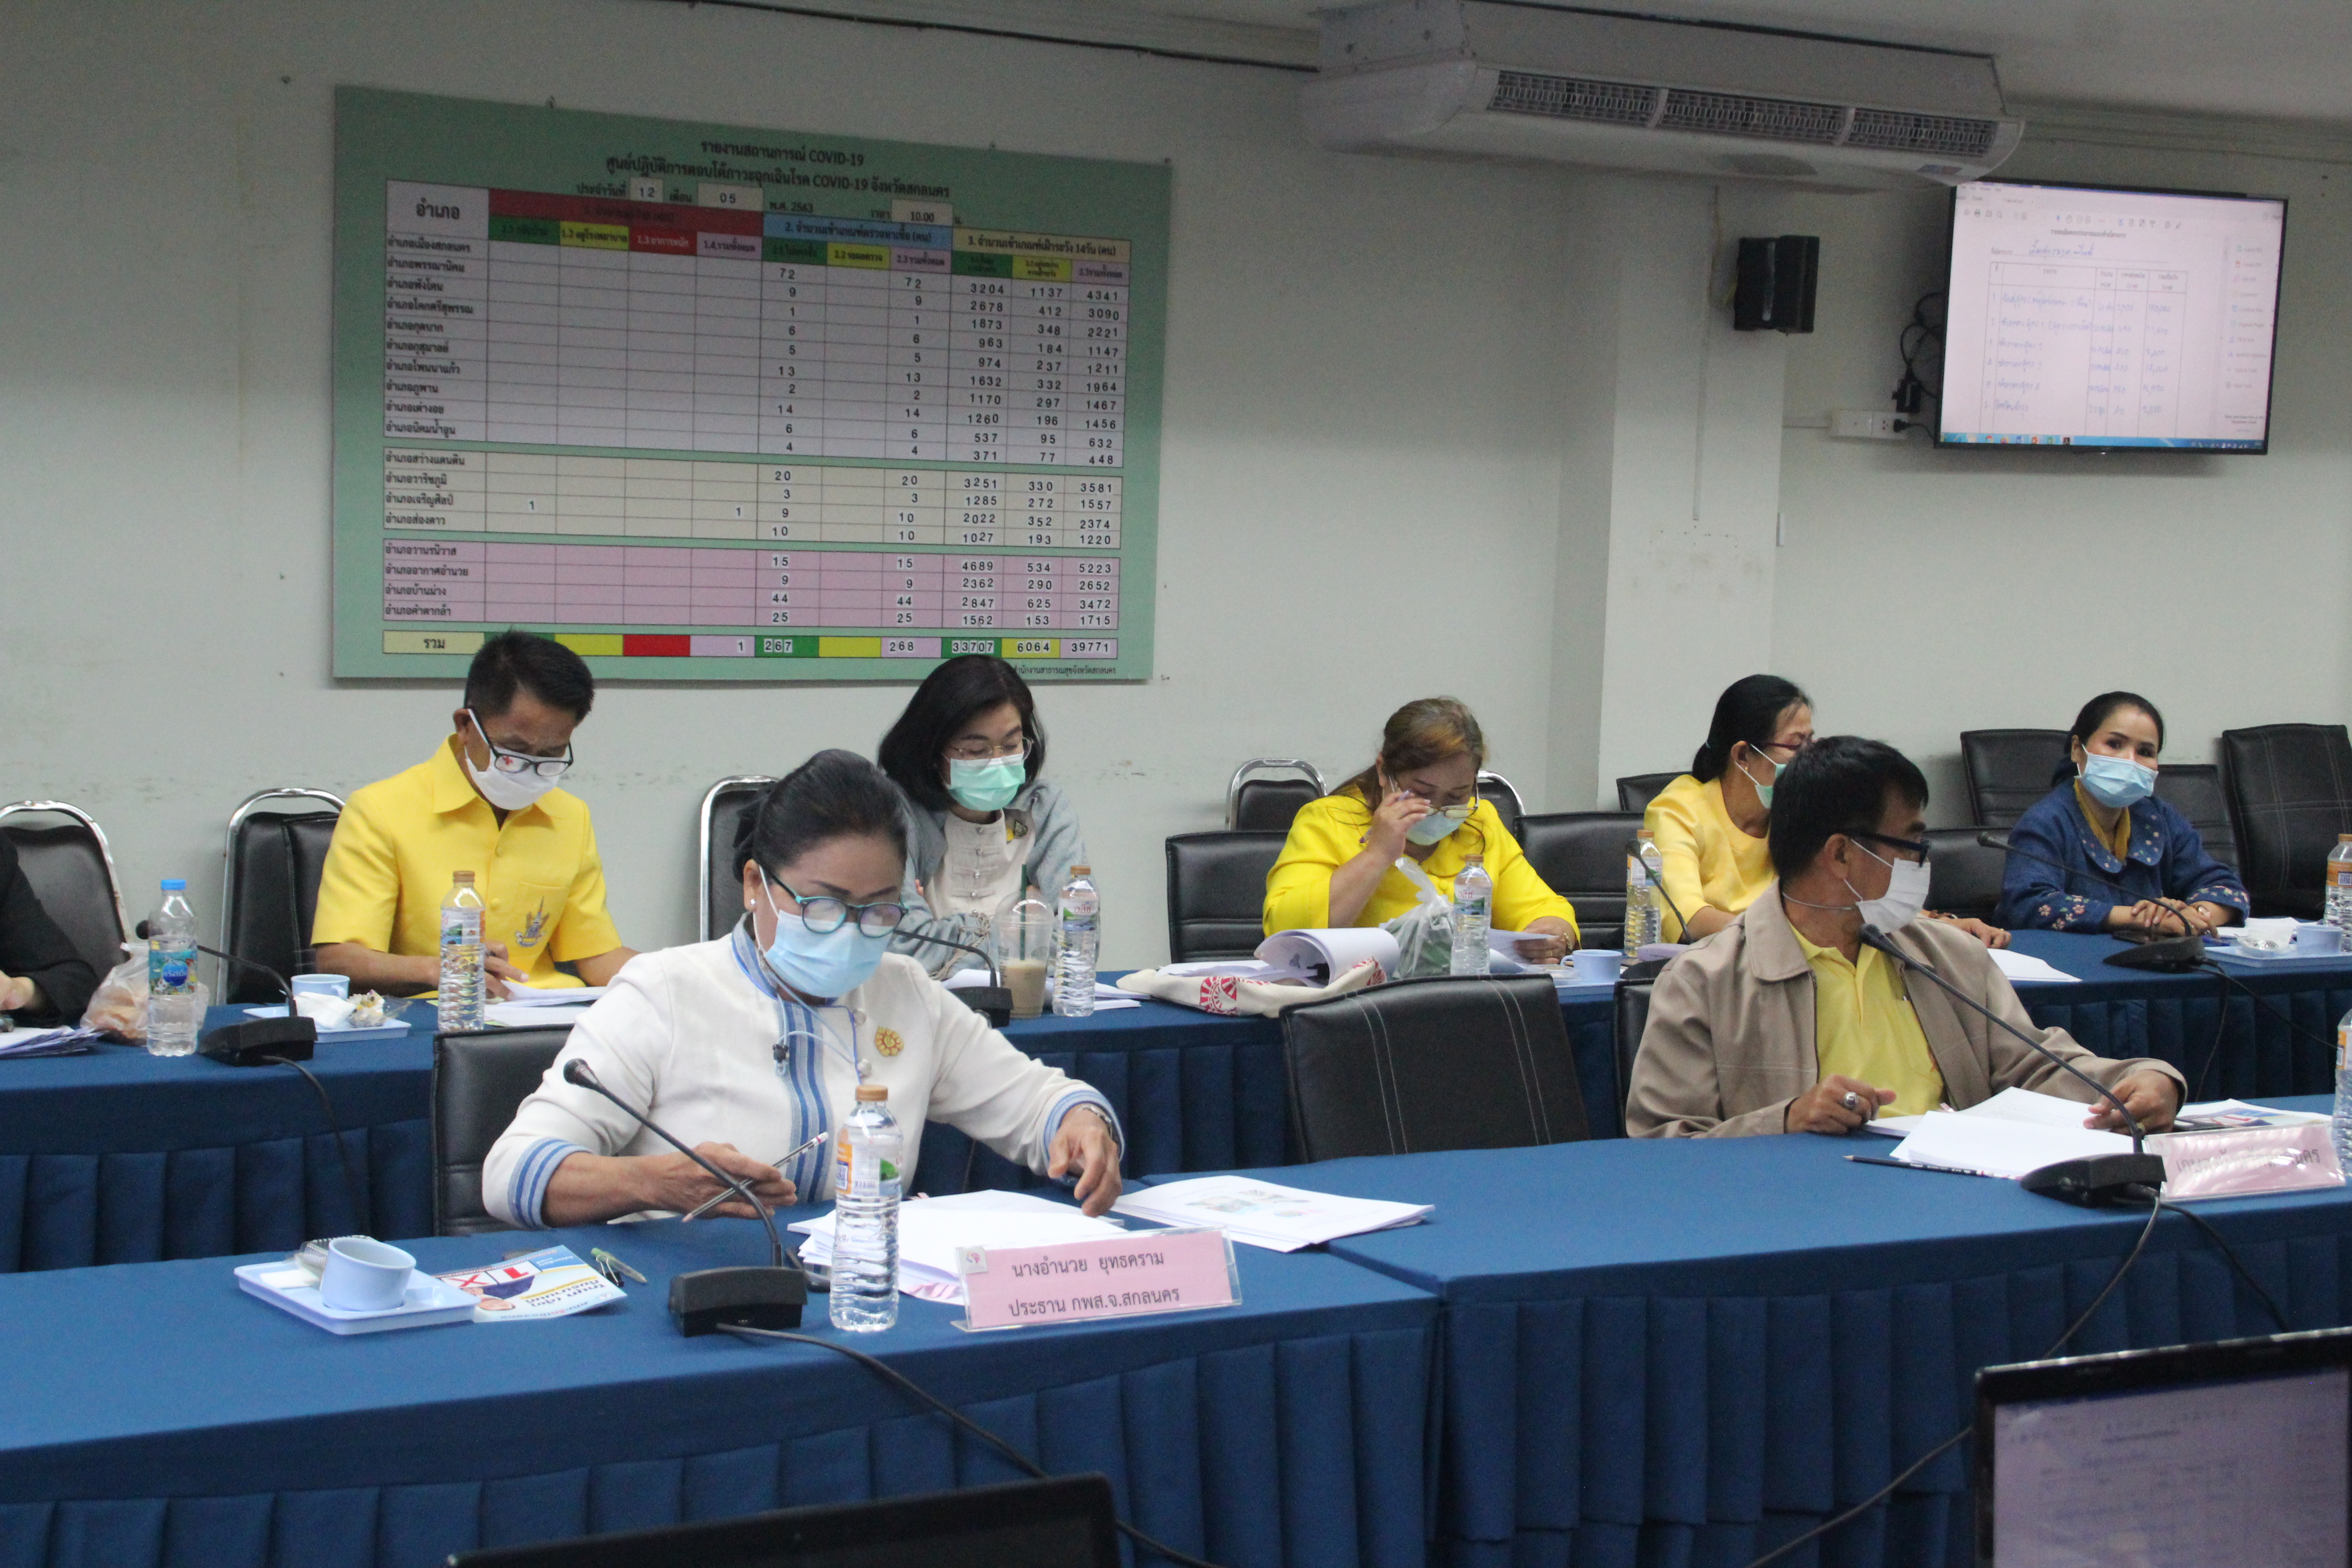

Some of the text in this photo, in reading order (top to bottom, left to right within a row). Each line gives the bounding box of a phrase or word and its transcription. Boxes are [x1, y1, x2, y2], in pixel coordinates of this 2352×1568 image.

[809, 149, 864, 167] COVID-19
[813, 174, 867, 191] COVID-19
[871, 176, 950, 197] จังหวัดสกลนคร
[416, 197, 460, 220] อำเภอ
[639, 186, 656, 198] 12
[720, 192, 737, 204] 05
[910, 210, 935, 223] 10.00
[780, 268, 795, 280] 72
[906, 277, 921, 289] 72
[789, 287, 796, 297] 9
[971, 283, 1004, 294] 3204
[1031, 287, 1063, 298] 1137
[915, 295, 922, 306] 9
[1087, 291, 1117, 301] 4341
[970, 300, 1003, 312] 2678
[790, 307, 794, 317] 1
[1039, 306, 1062, 317] 412
[1088, 308, 1119, 321] 3090
[915, 315, 919, 324] 1
[972, 318, 1002, 330] 1873
[789, 325, 795, 336] 6
[1038, 324, 1060, 336] 348
[1088, 327, 1117, 338] 2221
[913, 333, 920, 344] 6
[979, 337, 1003, 348] 963
[789, 344, 796, 355] 5
[1039, 343, 1062, 354] 184
[1089, 346, 1118, 357] 1147
[915, 353, 921, 363] 5
[978, 357, 1000, 368] 974
[1036, 360, 1061, 372] 237
[1088, 363, 1117, 375] 1211
[779, 366, 795, 377] 13
[906, 372, 921, 382] 13
[971, 376, 1001, 387] 1632
[789, 384, 795, 394] 2
[1038, 379, 1061, 390] 332
[1087, 382, 1117, 392] 1964
[914, 390, 920, 400] 2
[970, 393, 1001, 405] 1170
[1037, 397, 1060, 408] 297
[1087, 400, 1116, 410] 1467
[779, 405, 793, 414] 14
[906, 408, 920, 417] 14
[968, 413, 999, 425] 1260
[1037, 415, 1058, 426] 196
[1086, 419, 1116, 429] 1456
[786, 424, 793, 434] 6
[911, 429, 918, 439] 6
[975, 433, 998, 443] 537
[1040, 434, 1056, 444] 95
[1089, 438, 1112, 448] 632
[786, 442, 793, 451] 4
[911, 446, 918, 455] 4
[974, 451, 996, 461] 371
[1040, 452, 1055, 462] 77
[1089, 455, 1113, 465] 448
[775, 470, 791, 481] 20
[902, 475, 917, 486] 20
[965, 477, 996, 489] 3251
[1029, 481, 1053, 491] 330
[1080, 483, 1112, 493] 3581
[784, 489, 790, 499] 3
[911, 493, 918, 503] 3
[529, 500, 534, 510] 1
[966, 495, 997, 505] 1285
[1029, 498, 1053, 509] 272
[1081, 499, 1111, 510] 1557
[736, 507, 740, 516] 1
[782, 508, 789, 518] 9
[899, 512, 914, 523] 10
[963, 513, 995, 524] 2022
[1028, 516, 1052, 527] 352
[1080, 519, 1110, 529] 2374
[773, 526, 788, 536] 10
[900, 530, 915, 540] 10
[963, 532, 993, 543] 1027
[1029, 534, 1051, 545] 193
[1080, 535, 1111, 545] 1220
[774, 557, 789, 566] 15
[898, 559, 913, 568] 15
[962, 561, 993, 571] 4689
[1028, 563, 1050, 572] 534
[1079, 563, 1111, 573] 5223
[782, 575, 789, 585] 9
[906, 579, 913, 588] 9
[963, 578, 994, 588] 2362
[1028, 579, 1052, 590] 290
[1079, 581, 1110, 591] 2652
[773, 594, 788, 603] 44
[897, 597, 911, 605] 44
[962, 597, 994, 608] 2847
[1028, 599, 1051, 608] 625
[1080, 599, 1111, 609] 3472
[773, 612, 788, 622] 25
[897, 613, 912, 623] 25
[963, 615, 993, 625] 1562
[1027, 615, 1049, 625] 153
[1081, 615, 1110, 625] 1715
[423, 636, 446, 651] รวม
[739, 642, 743, 651] 1
[764, 641, 792, 651] 267
[890, 641, 914, 652] 268
[952, 641, 994, 652] 33707
[1017, 642, 1049, 652] 6064
[1071, 642, 1108, 652] 39771
[1012, 1251, 1165, 1278] นางอำนวย ยุทธคราม
[1008, 1287, 1180, 1317] ประธาน กพส.จ.สกลนคร
